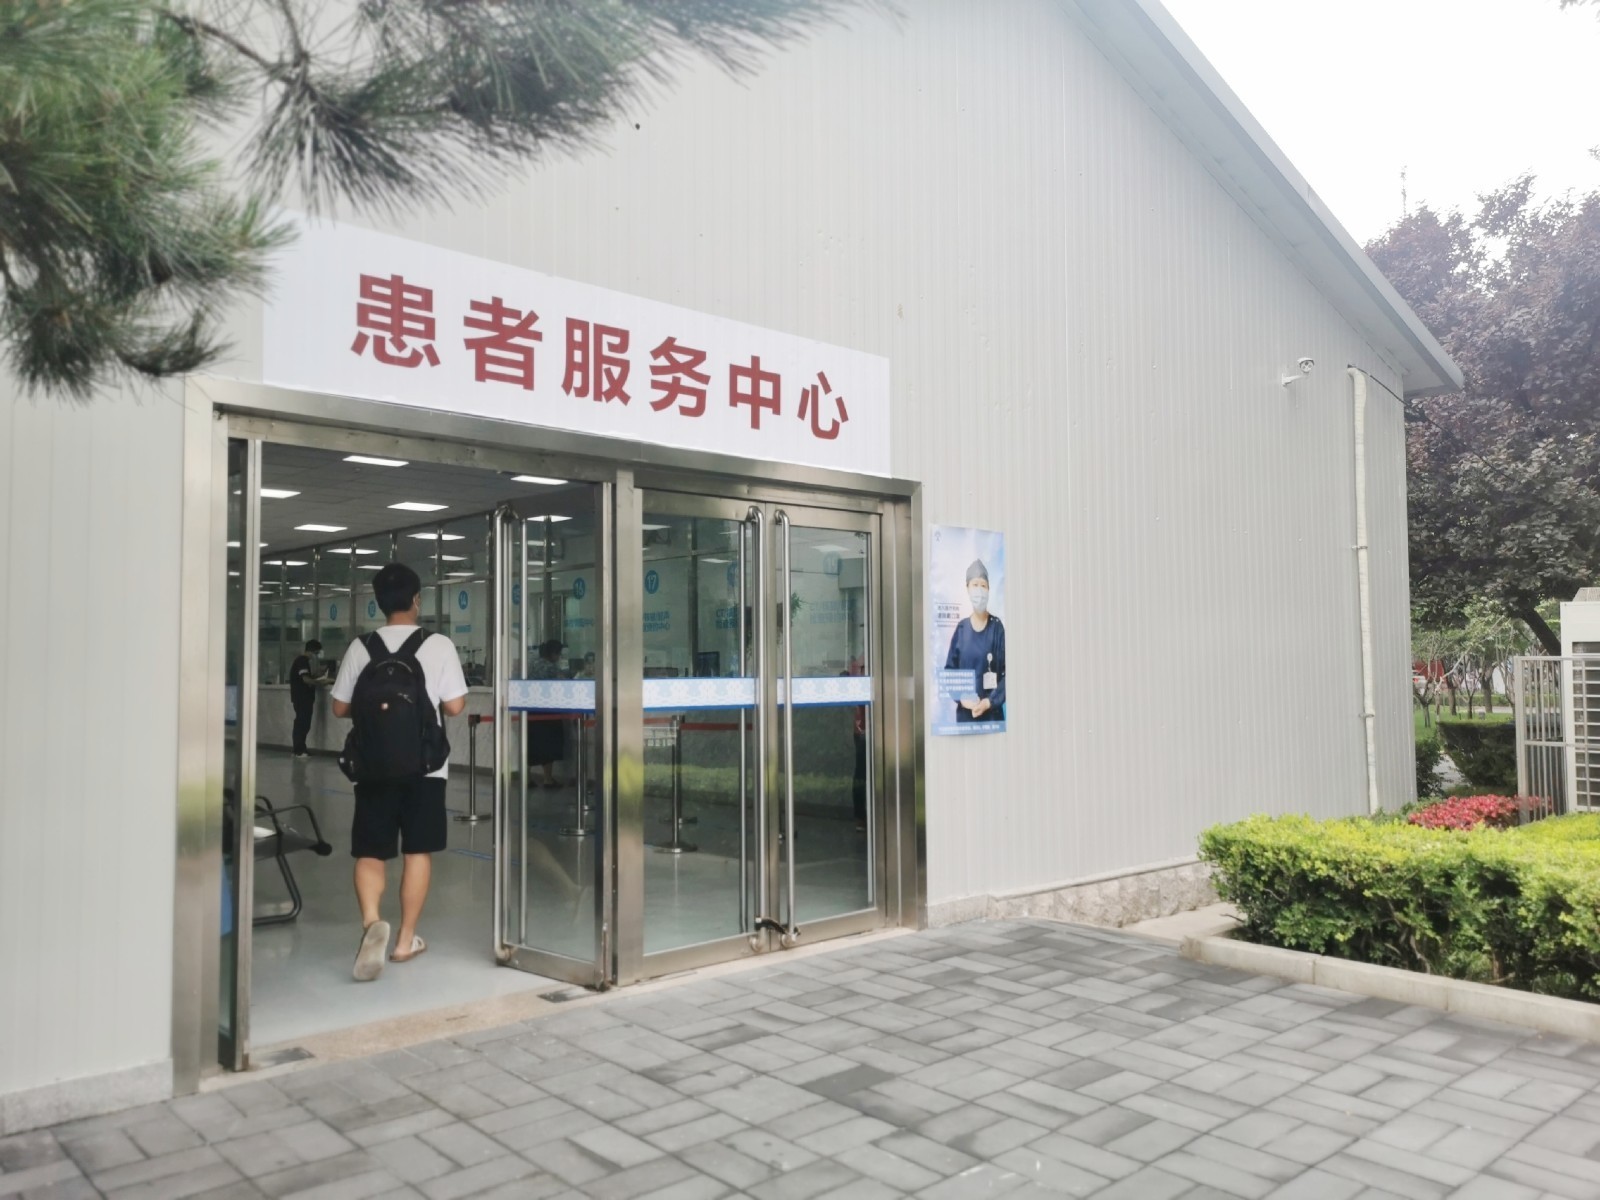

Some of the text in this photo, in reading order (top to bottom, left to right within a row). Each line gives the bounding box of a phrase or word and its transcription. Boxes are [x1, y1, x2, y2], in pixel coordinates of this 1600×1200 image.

[350, 273, 849, 440] 患者服务中心
